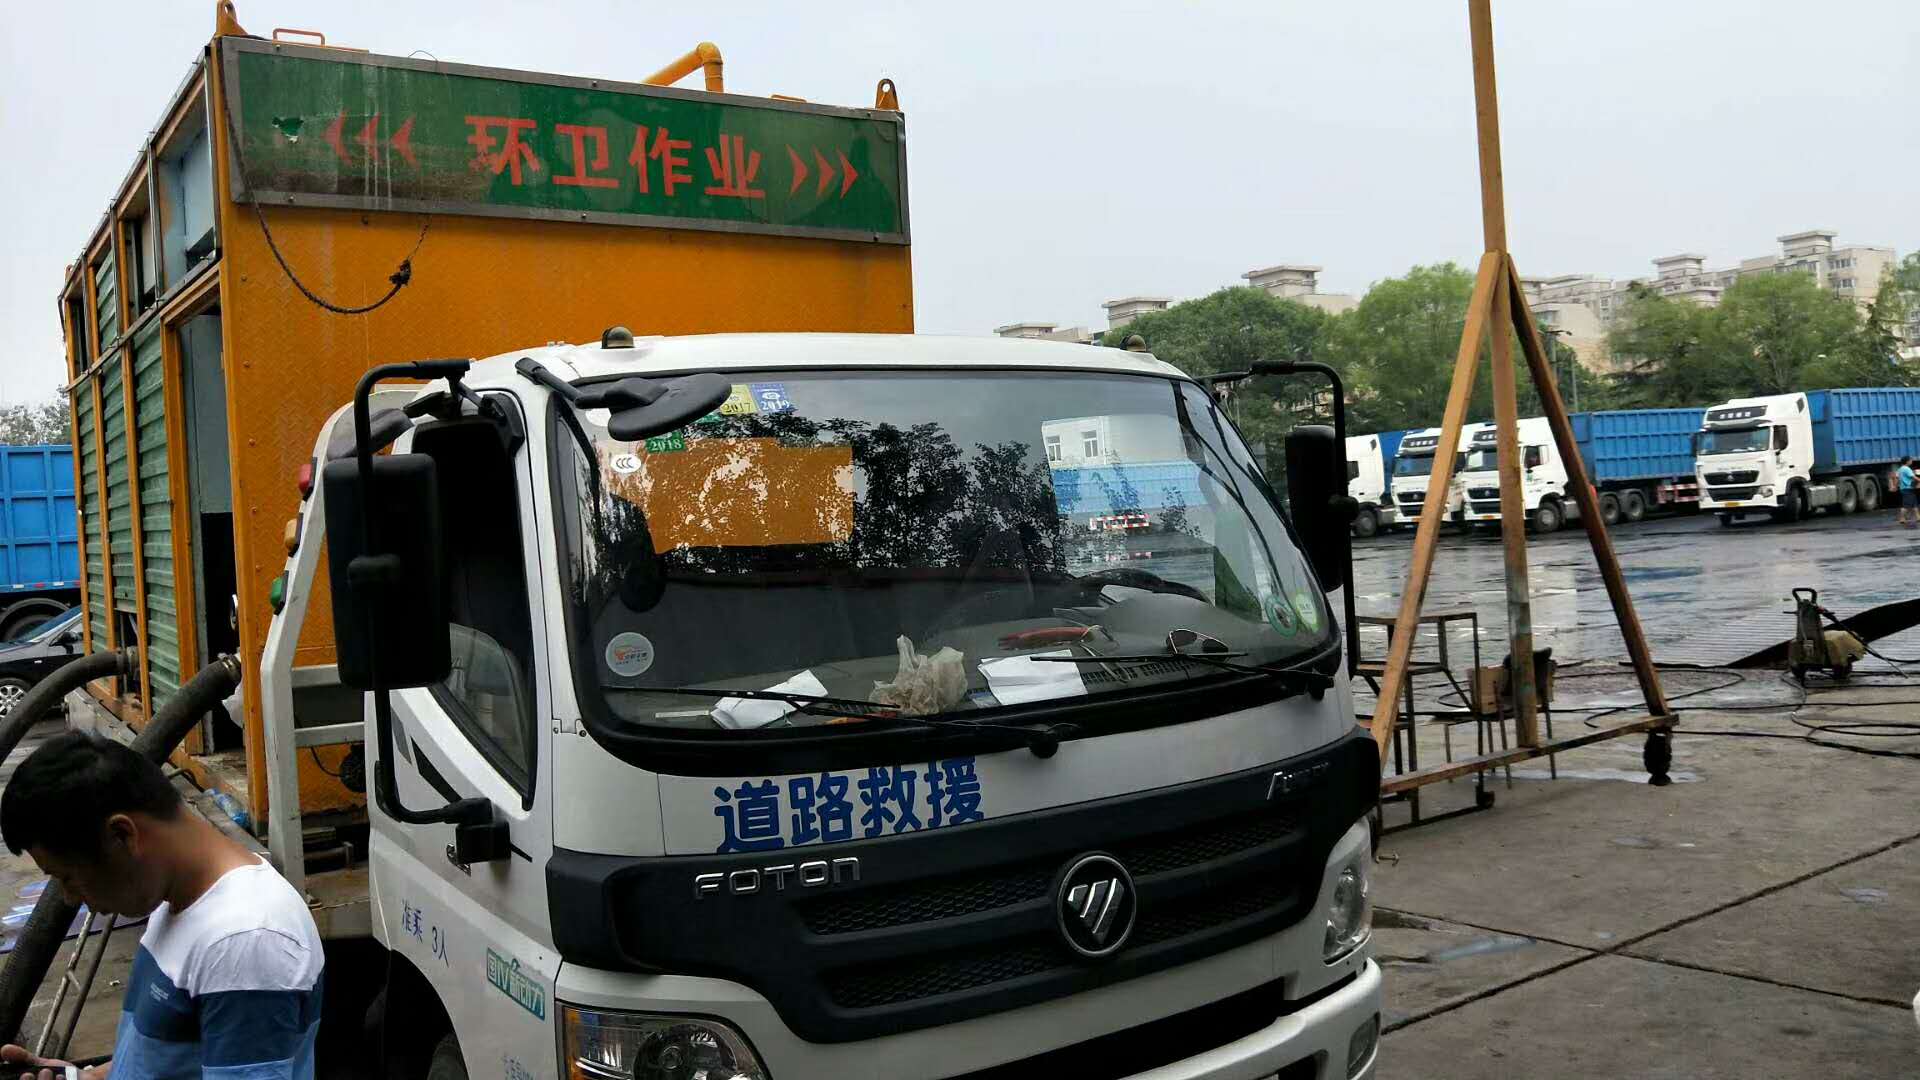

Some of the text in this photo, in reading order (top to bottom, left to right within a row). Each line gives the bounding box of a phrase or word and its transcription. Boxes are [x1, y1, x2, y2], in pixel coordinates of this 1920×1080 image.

[464, 115, 766, 199] 环卫作业
[722, 402, 752, 413] 2017
[651, 438, 682, 451] 2018
[714, 754, 984, 854] 道路救援
[695, 857, 860, 899] FOTON
